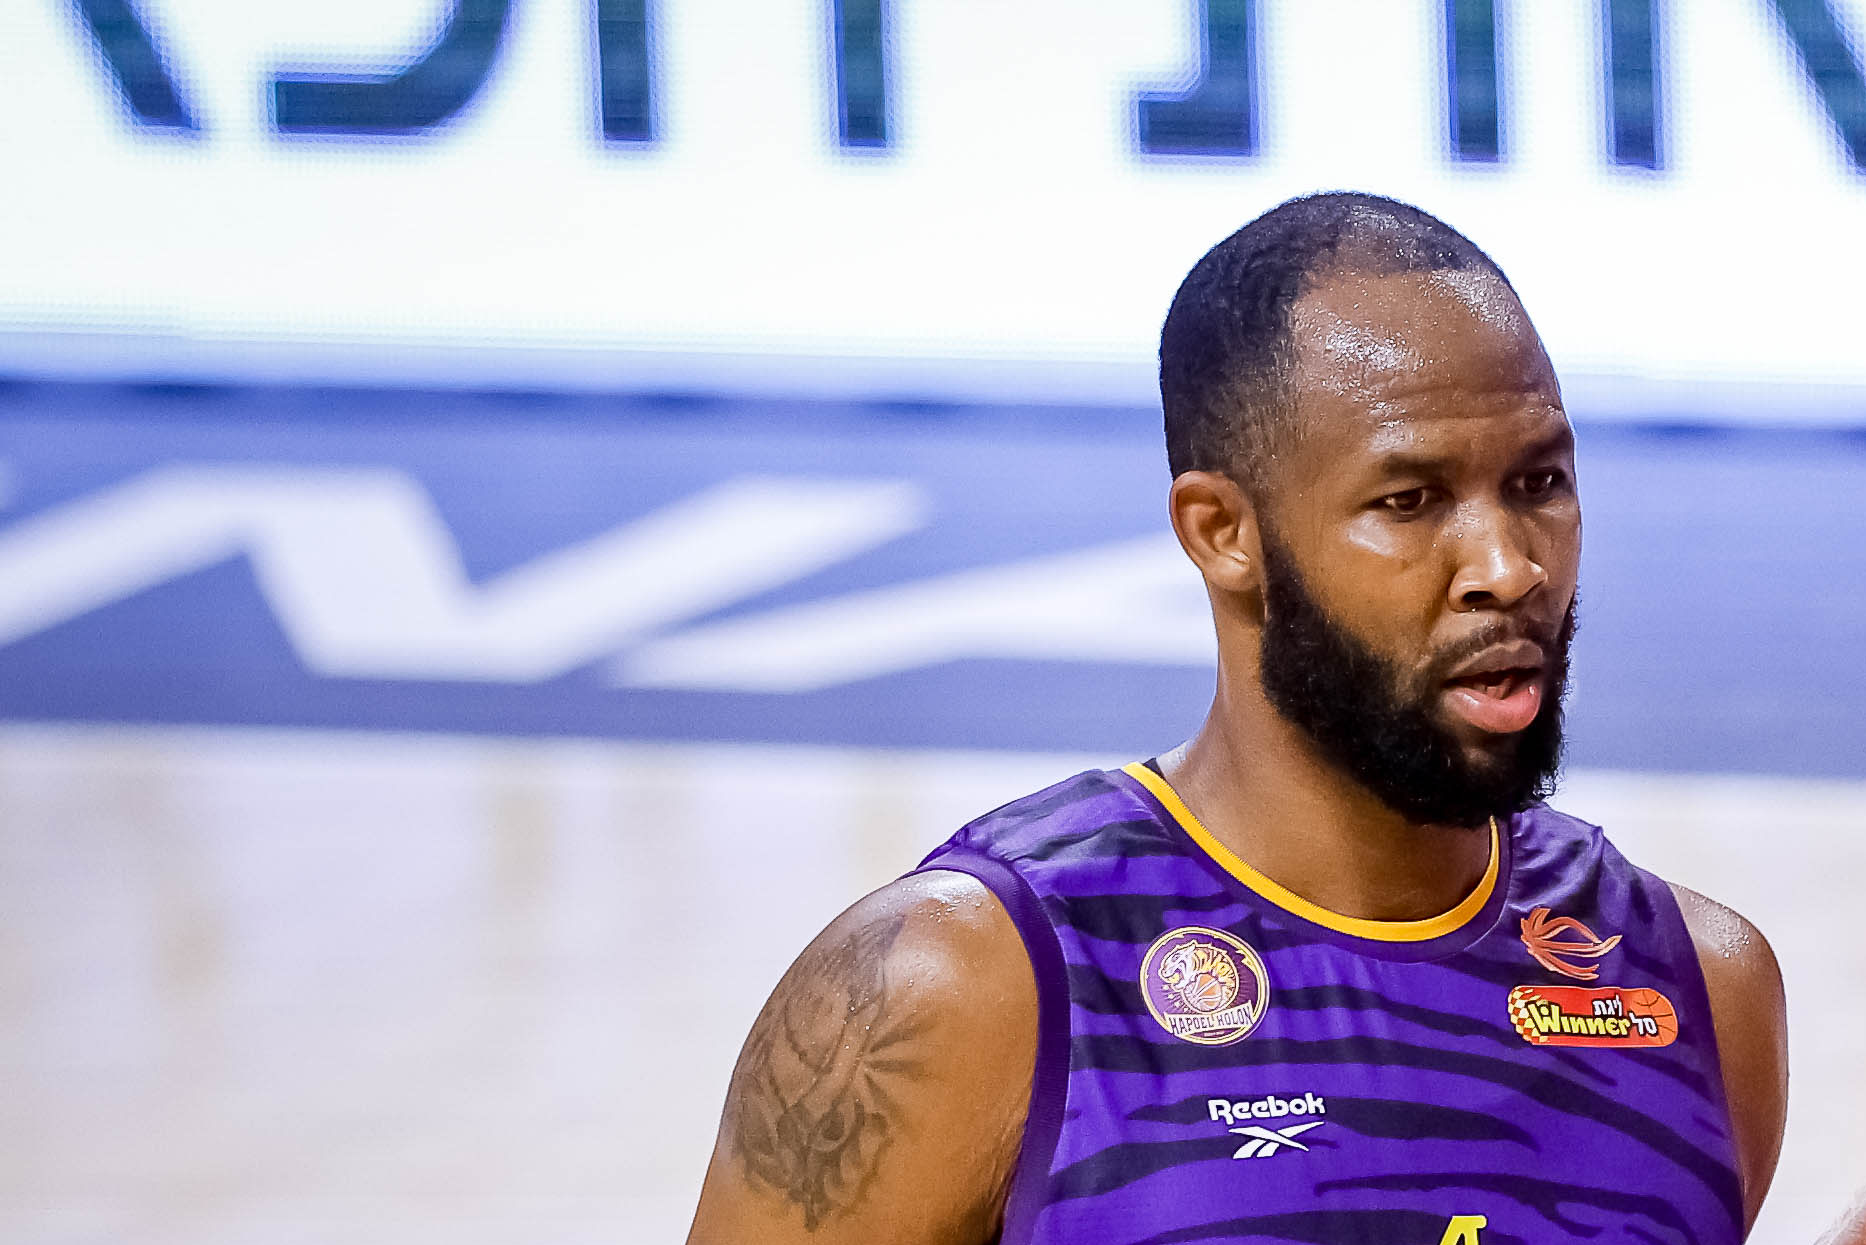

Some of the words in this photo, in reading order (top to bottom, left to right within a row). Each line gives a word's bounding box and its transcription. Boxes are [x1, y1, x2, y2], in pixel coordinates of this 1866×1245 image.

[1169, 1016, 1214, 1035] HAPOEL
[1216, 1006, 1254, 1027] HOLON
[1528, 1003, 1631, 1035] Winner
[1629, 1012, 1657, 1035] סל
[1592, 995, 1622, 1016] ליגת
[1208, 1092, 1326, 1125] Reebok
